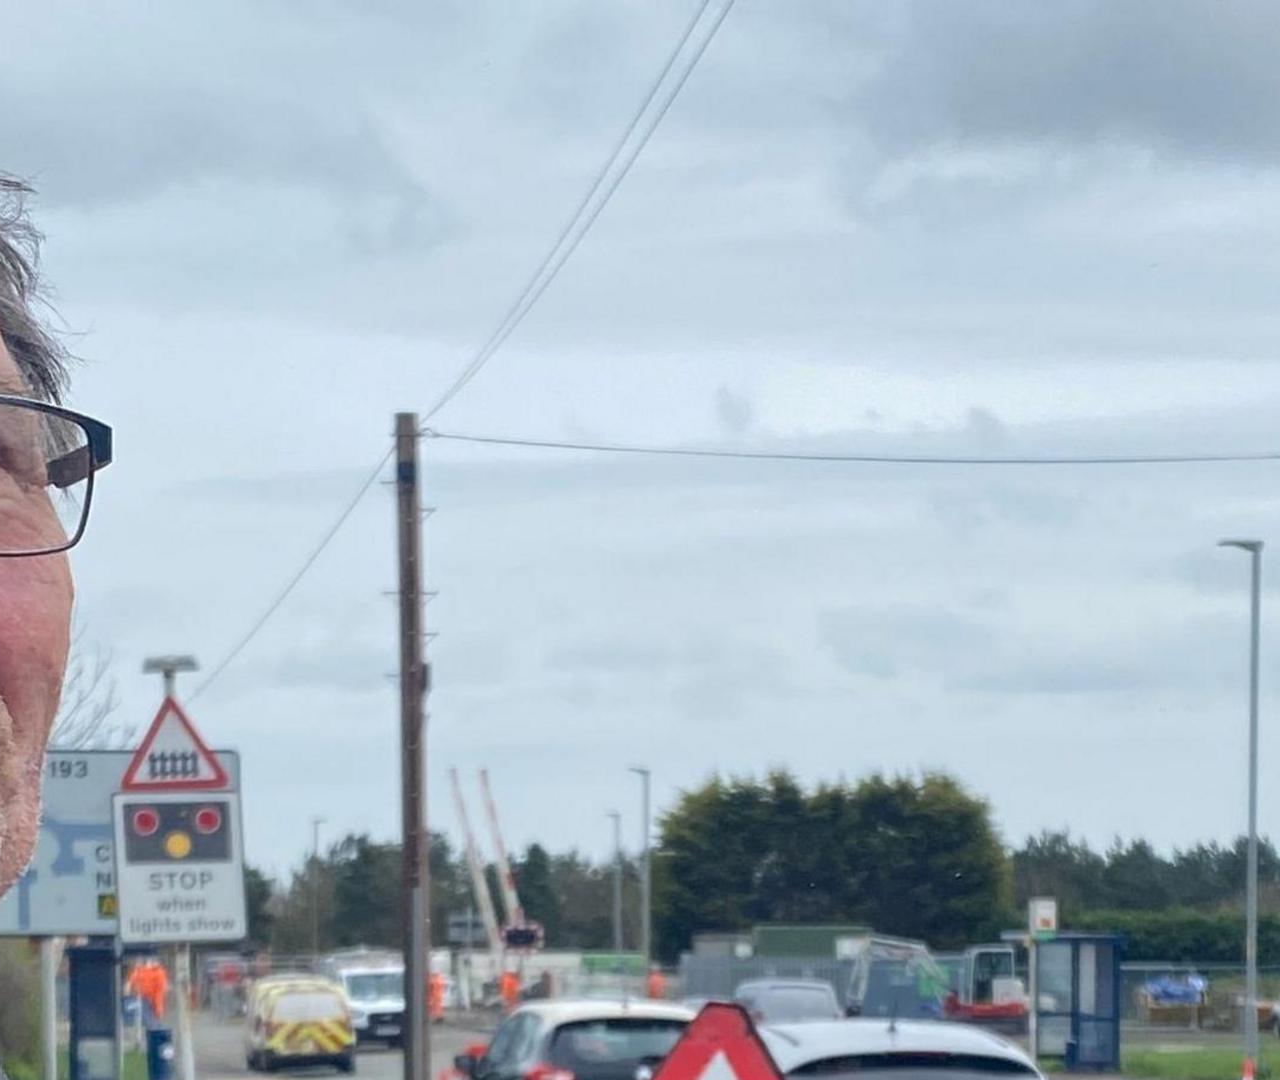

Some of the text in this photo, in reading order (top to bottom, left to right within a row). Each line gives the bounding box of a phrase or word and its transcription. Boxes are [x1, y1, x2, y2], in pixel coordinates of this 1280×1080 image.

[149, 871, 213, 890] STOP
[157, 896, 206, 911] when
[129, 917, 235, 935] lights show
